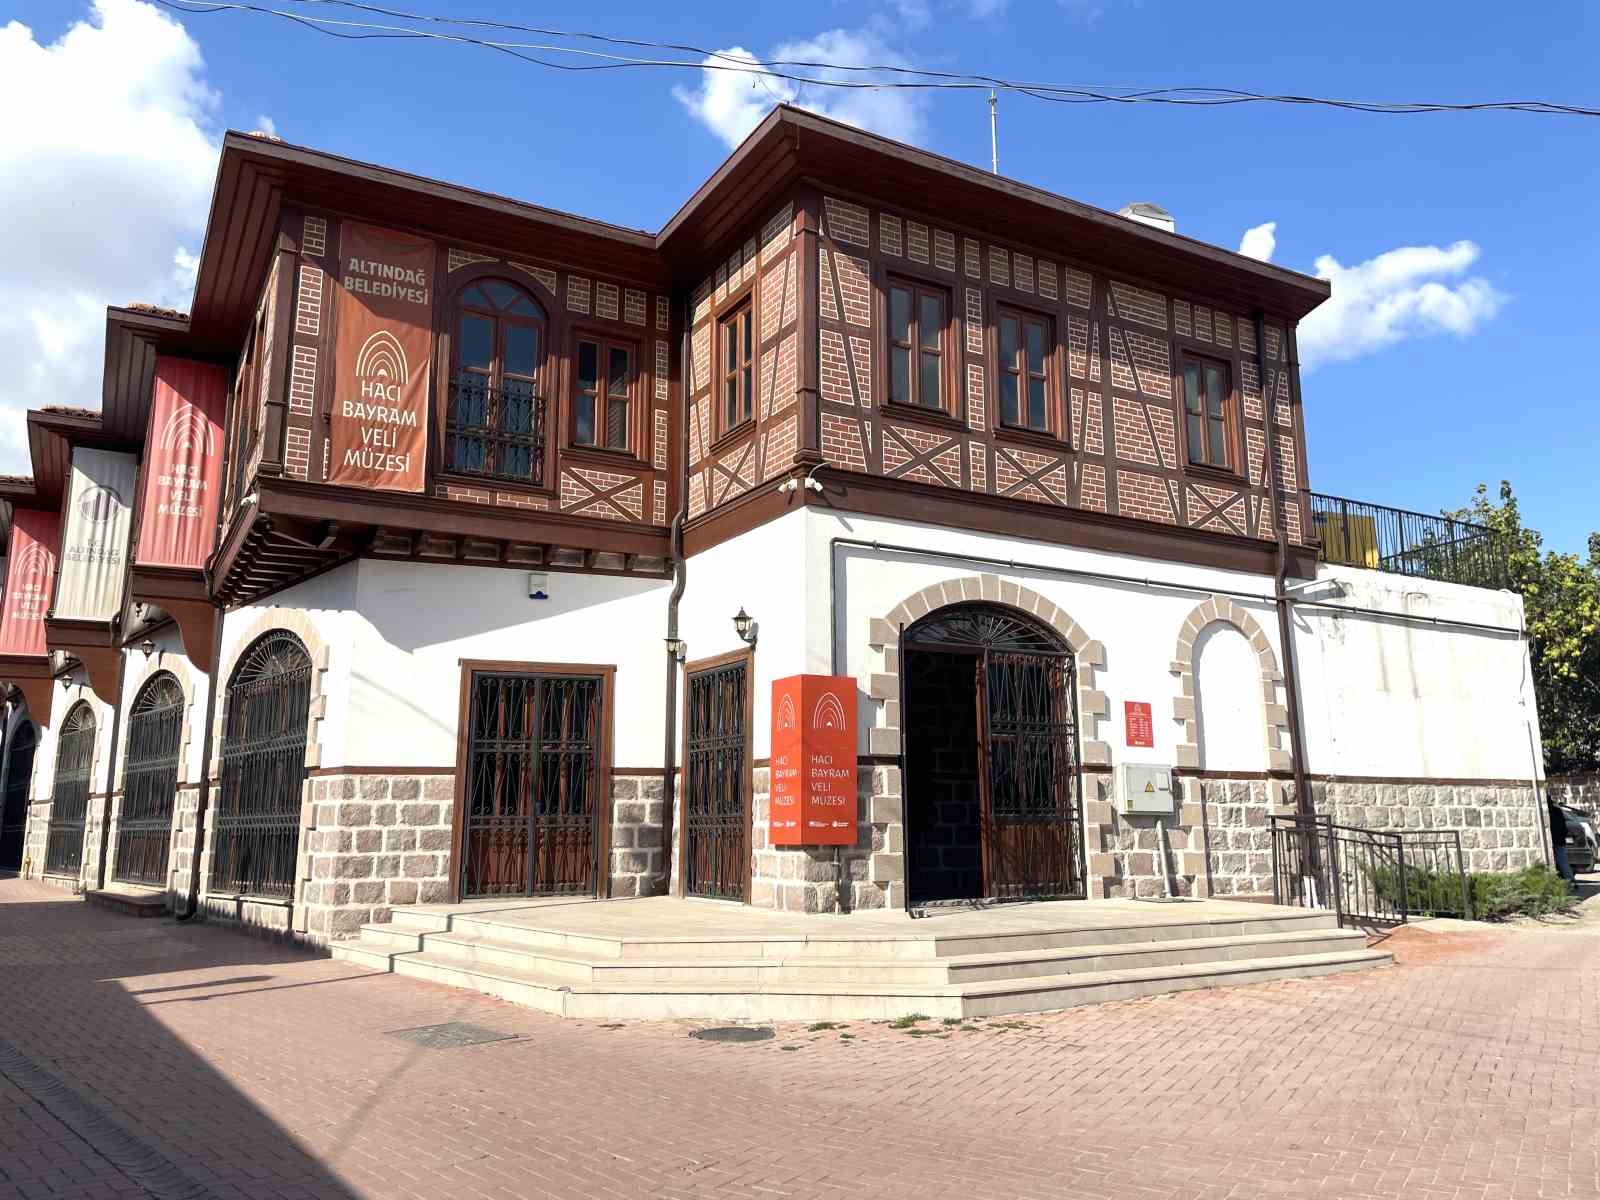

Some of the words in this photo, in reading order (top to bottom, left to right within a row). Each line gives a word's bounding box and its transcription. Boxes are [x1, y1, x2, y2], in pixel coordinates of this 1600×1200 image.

[349, 257, 425, 286] ALTINDAĞ
[344, 275, 429, 305] BELEDİYESİ
[361, 380, 401, 402] HACI
[342, 400, 417, 427] BAYRAM
[361, 426, 397, 448] VELİ
[343, 447, 410, 473] MÜZESİ
[811, 755, 833, 765] HACI
[811, 768, 850, 778] BAYRAM
